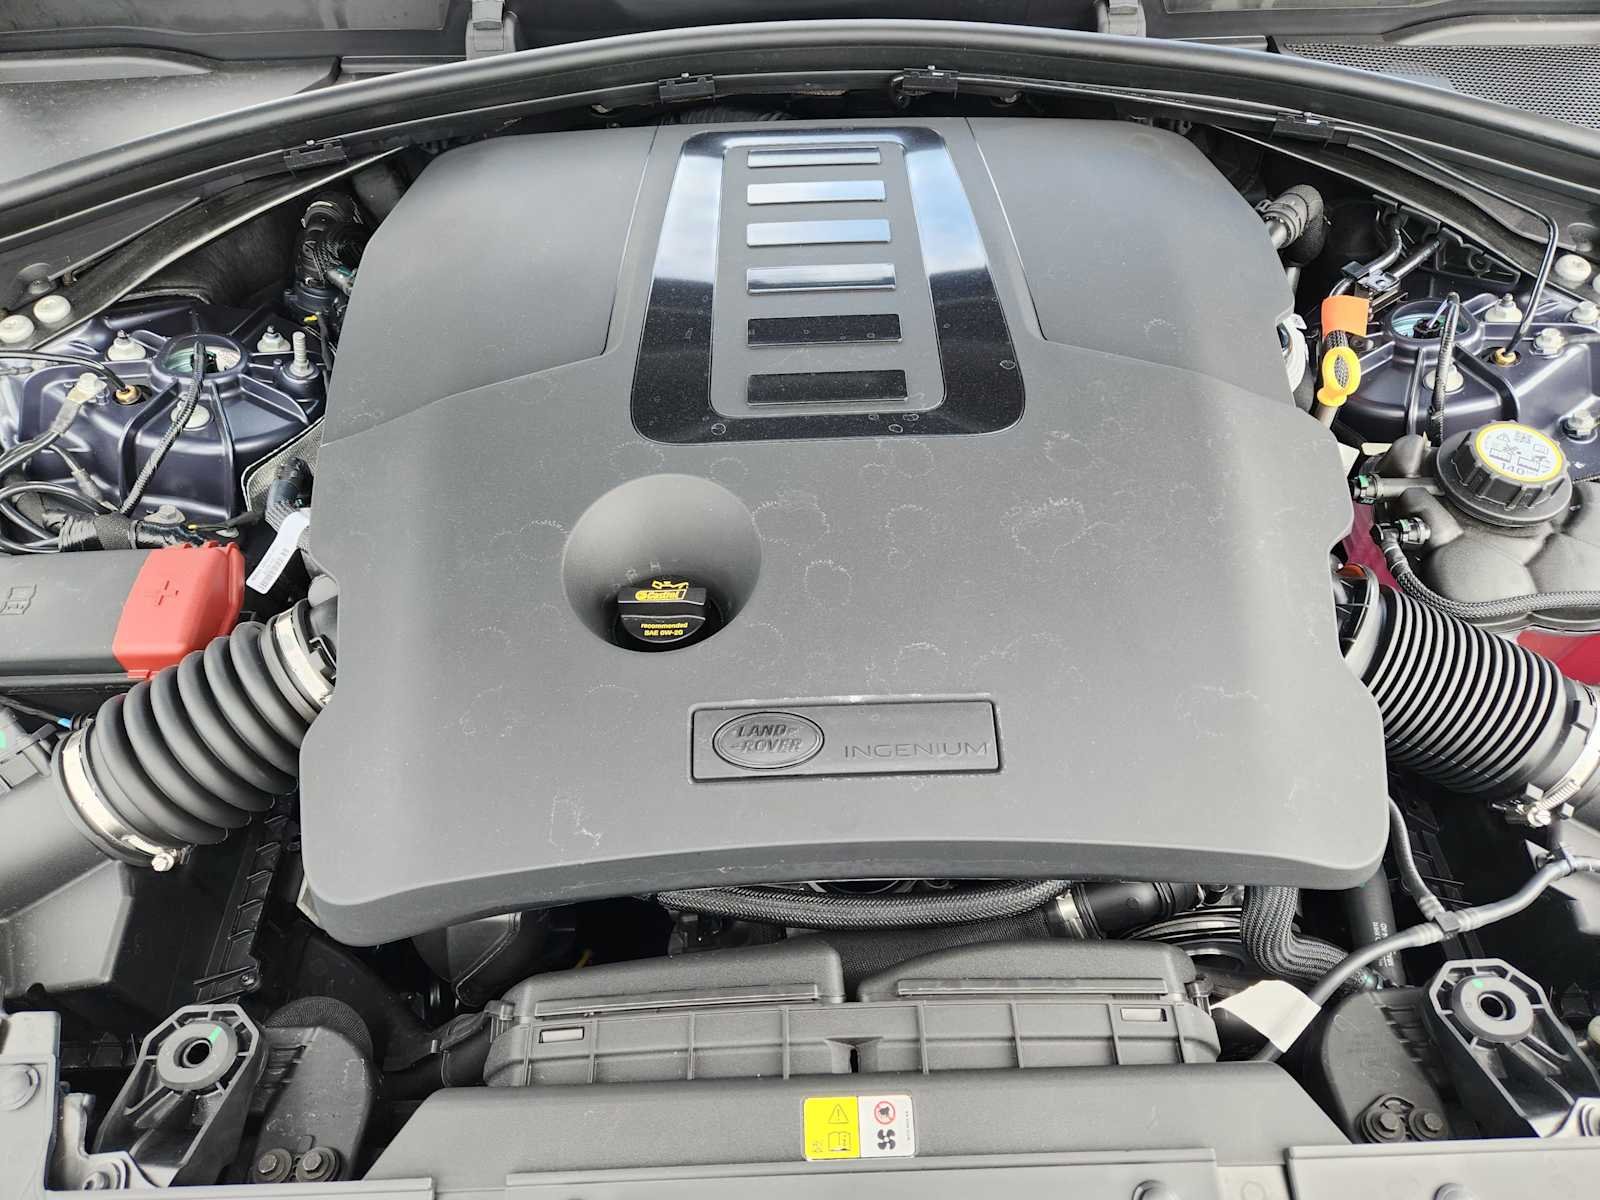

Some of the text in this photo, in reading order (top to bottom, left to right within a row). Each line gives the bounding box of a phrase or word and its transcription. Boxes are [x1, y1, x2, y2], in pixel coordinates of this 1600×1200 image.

[738, 724, 787, 737] LAND
[743, 738, 802, 753] ROVER
[844, 742, 988, 758] INGENIUM
